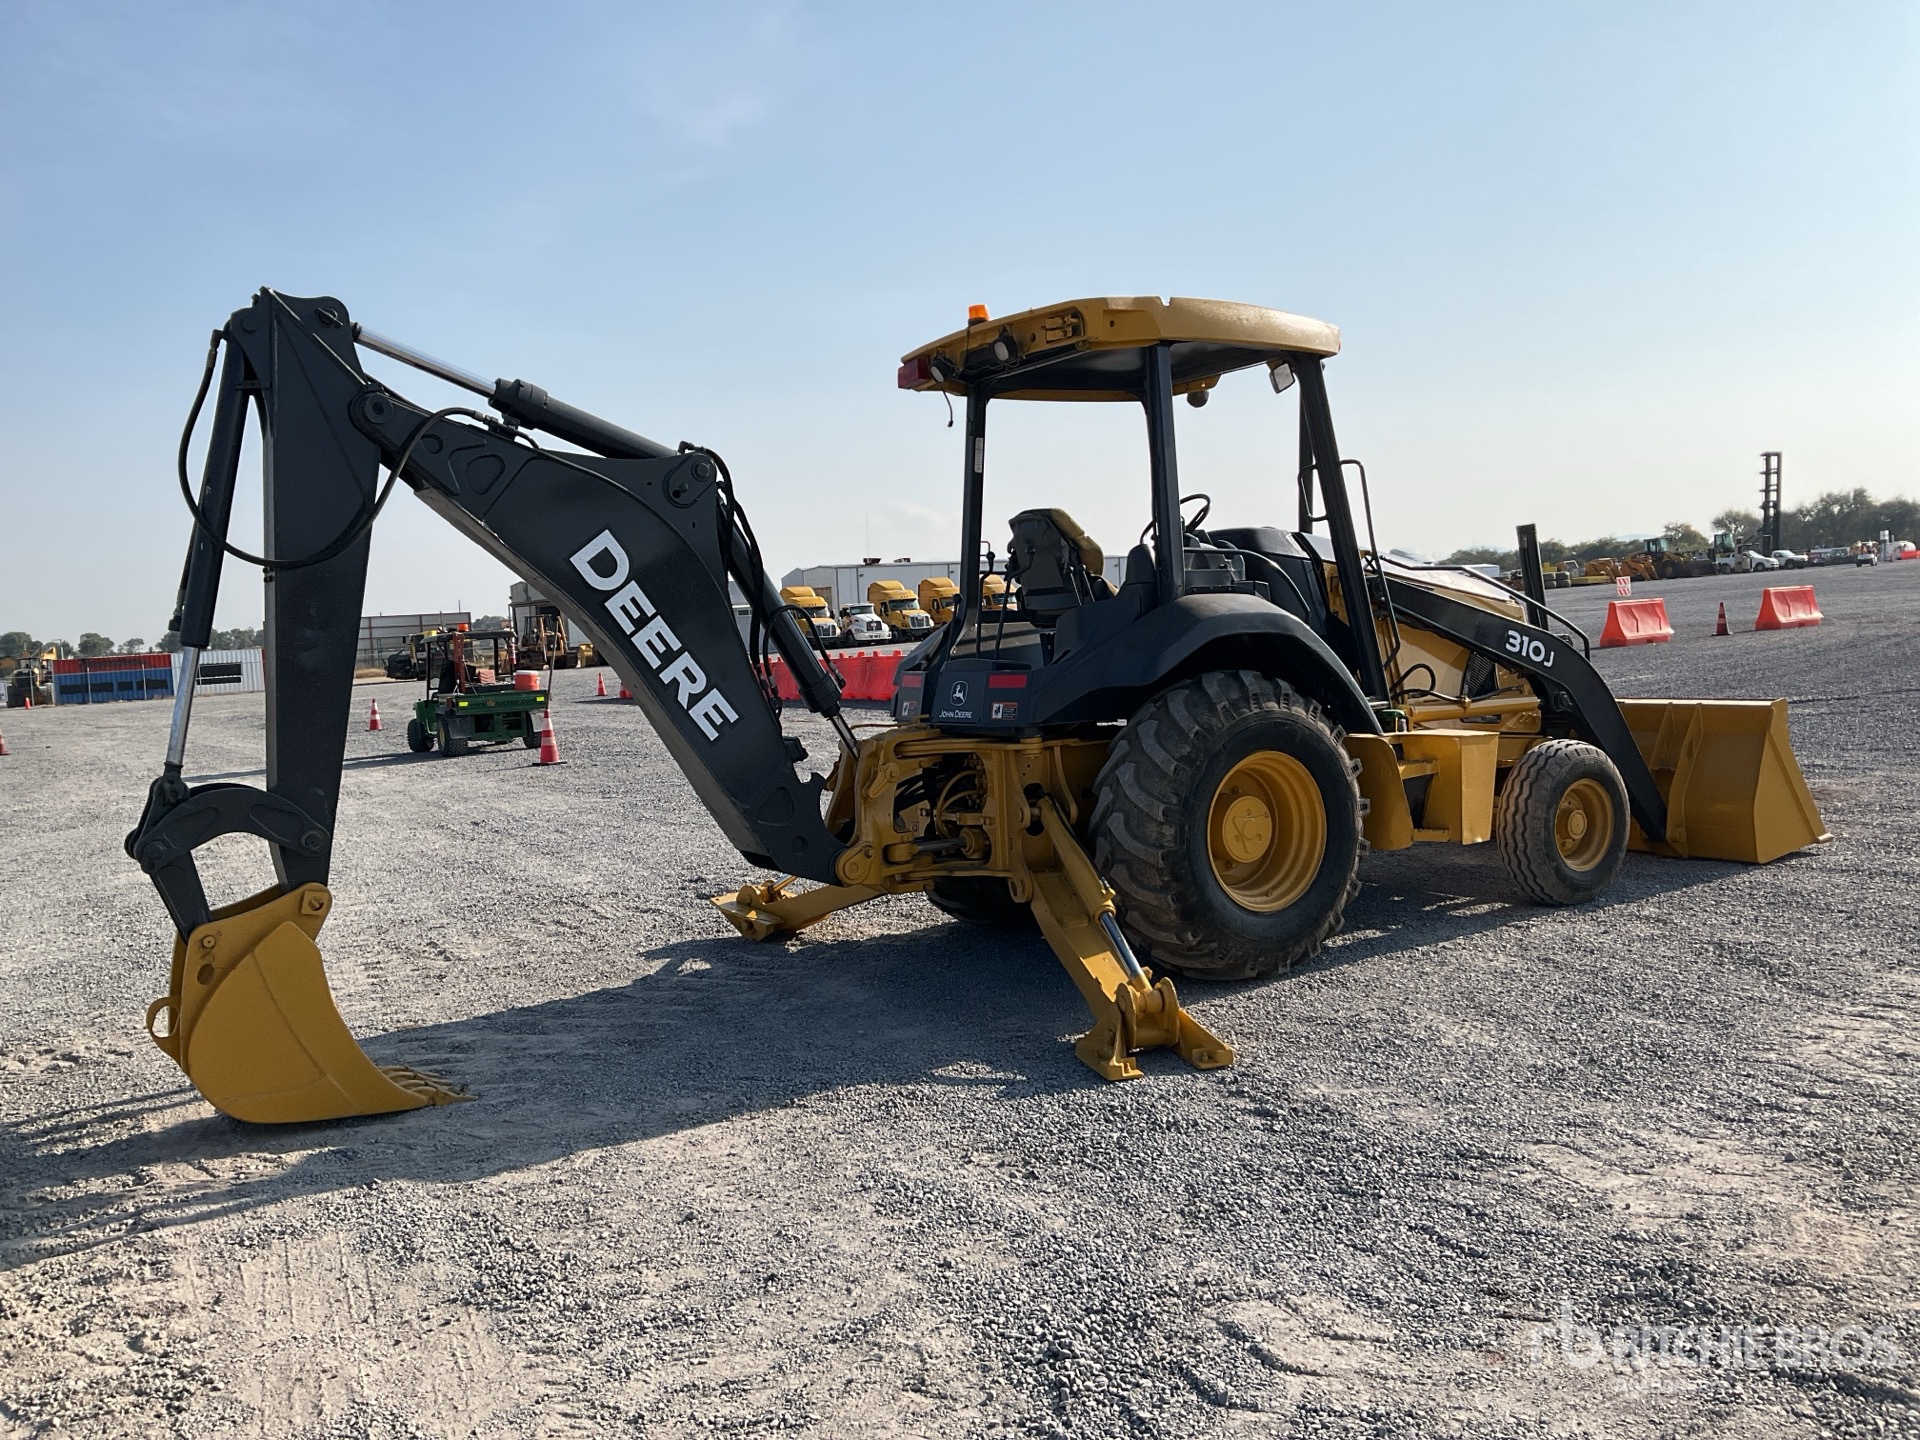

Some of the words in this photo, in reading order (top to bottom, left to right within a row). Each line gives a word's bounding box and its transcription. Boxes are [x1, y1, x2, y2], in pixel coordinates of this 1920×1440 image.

[569, 528, 739, 742] DEERE
[1505, 629, 1555, 668] 310J
[939, 710, 954, 718] JOHN
[955, 710, 973, 719] DEERE
